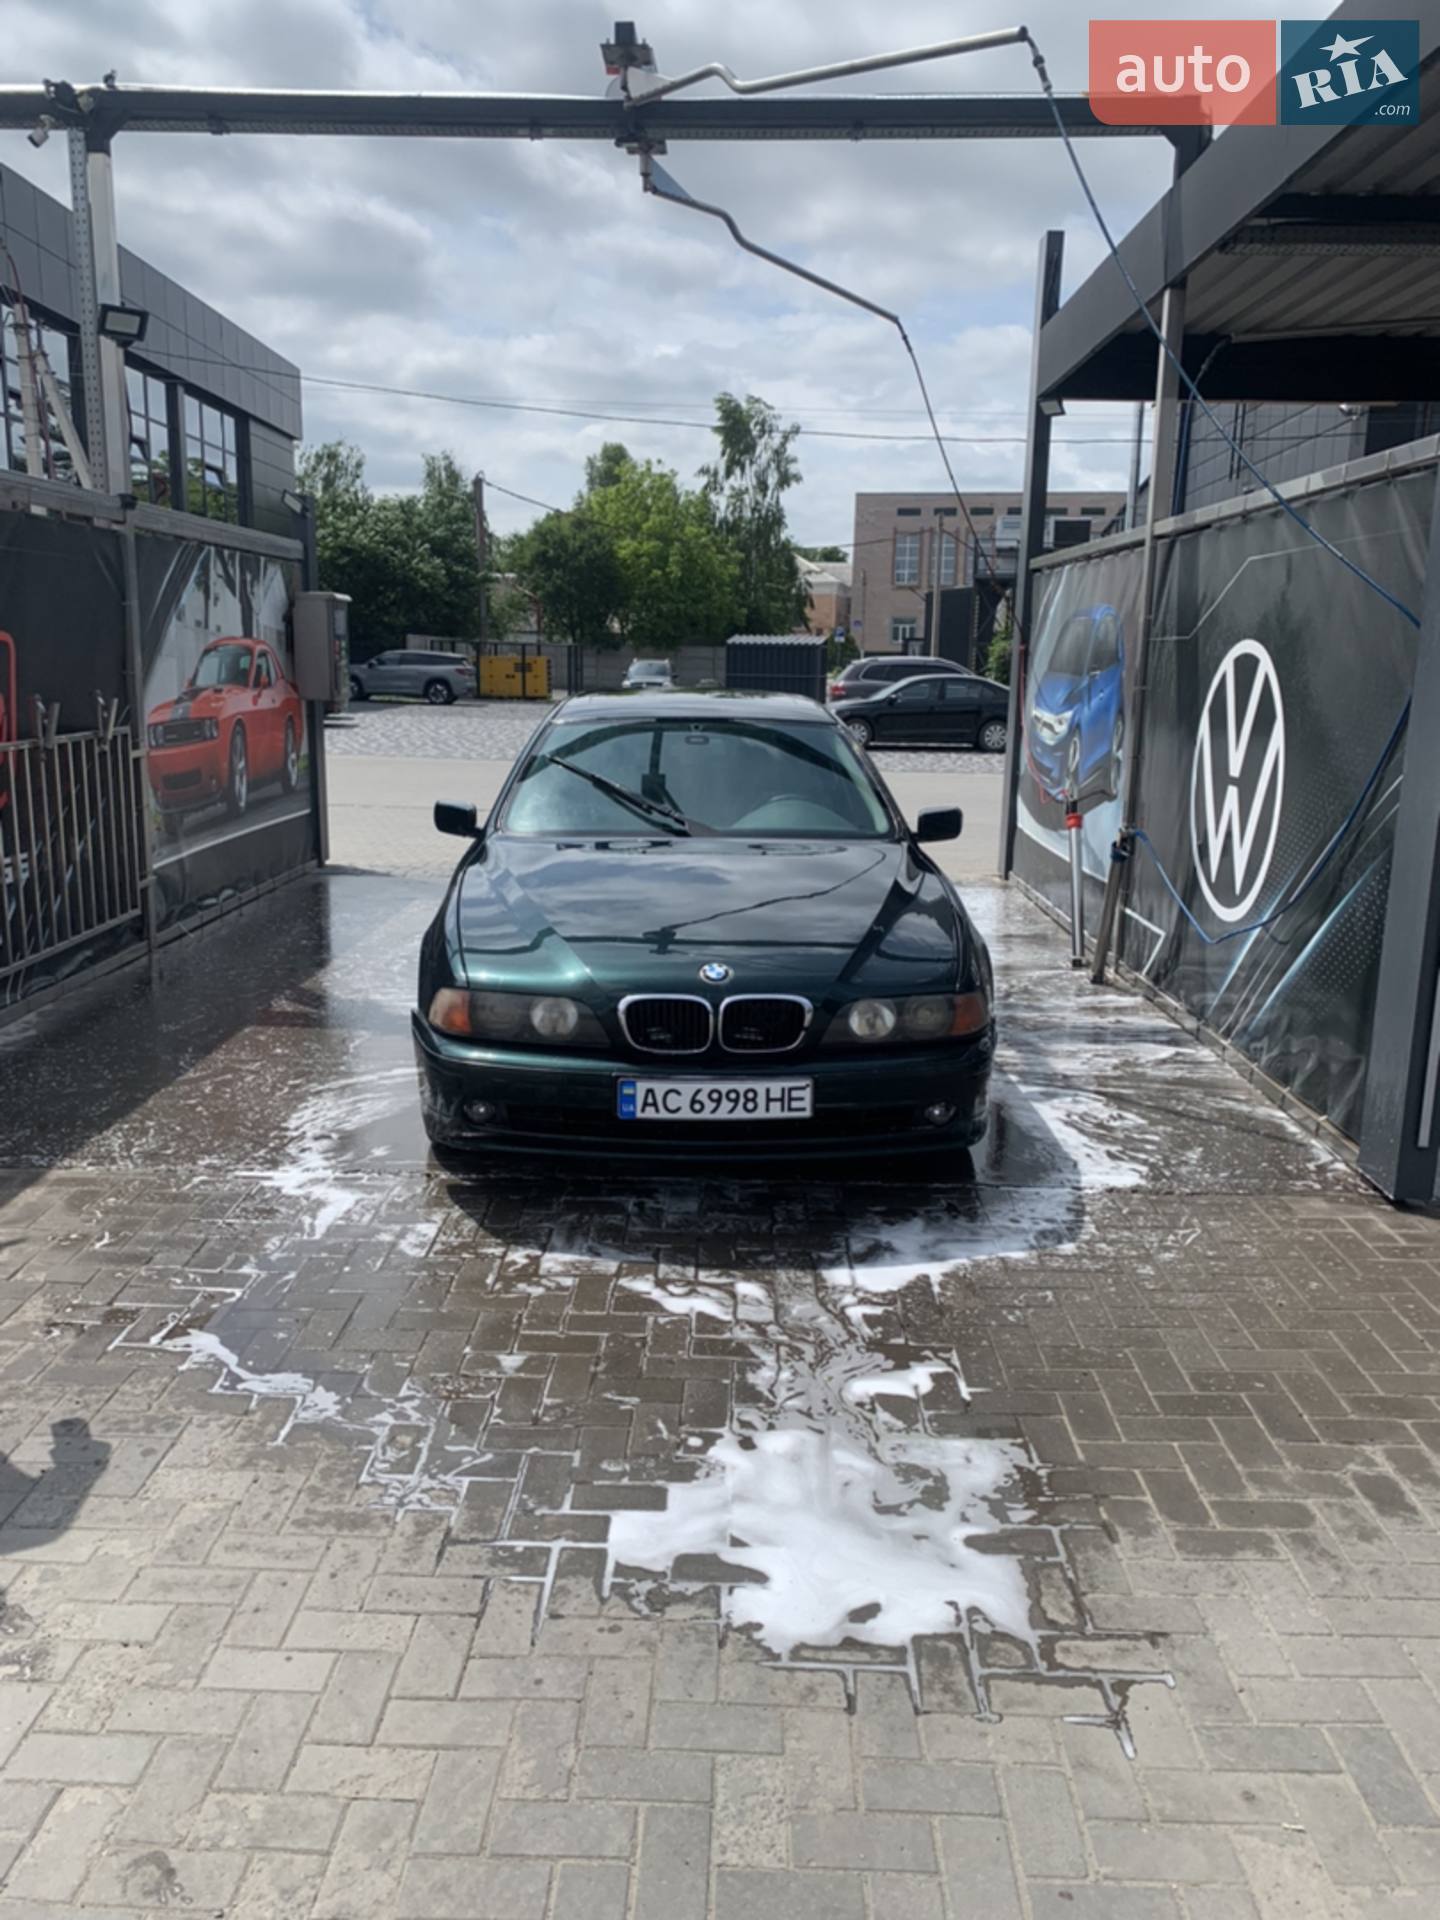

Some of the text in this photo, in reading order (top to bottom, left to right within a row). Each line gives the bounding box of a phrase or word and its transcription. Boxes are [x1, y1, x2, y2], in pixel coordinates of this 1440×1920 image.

[640, 1085, 810, 1115] AC 6998 HE
